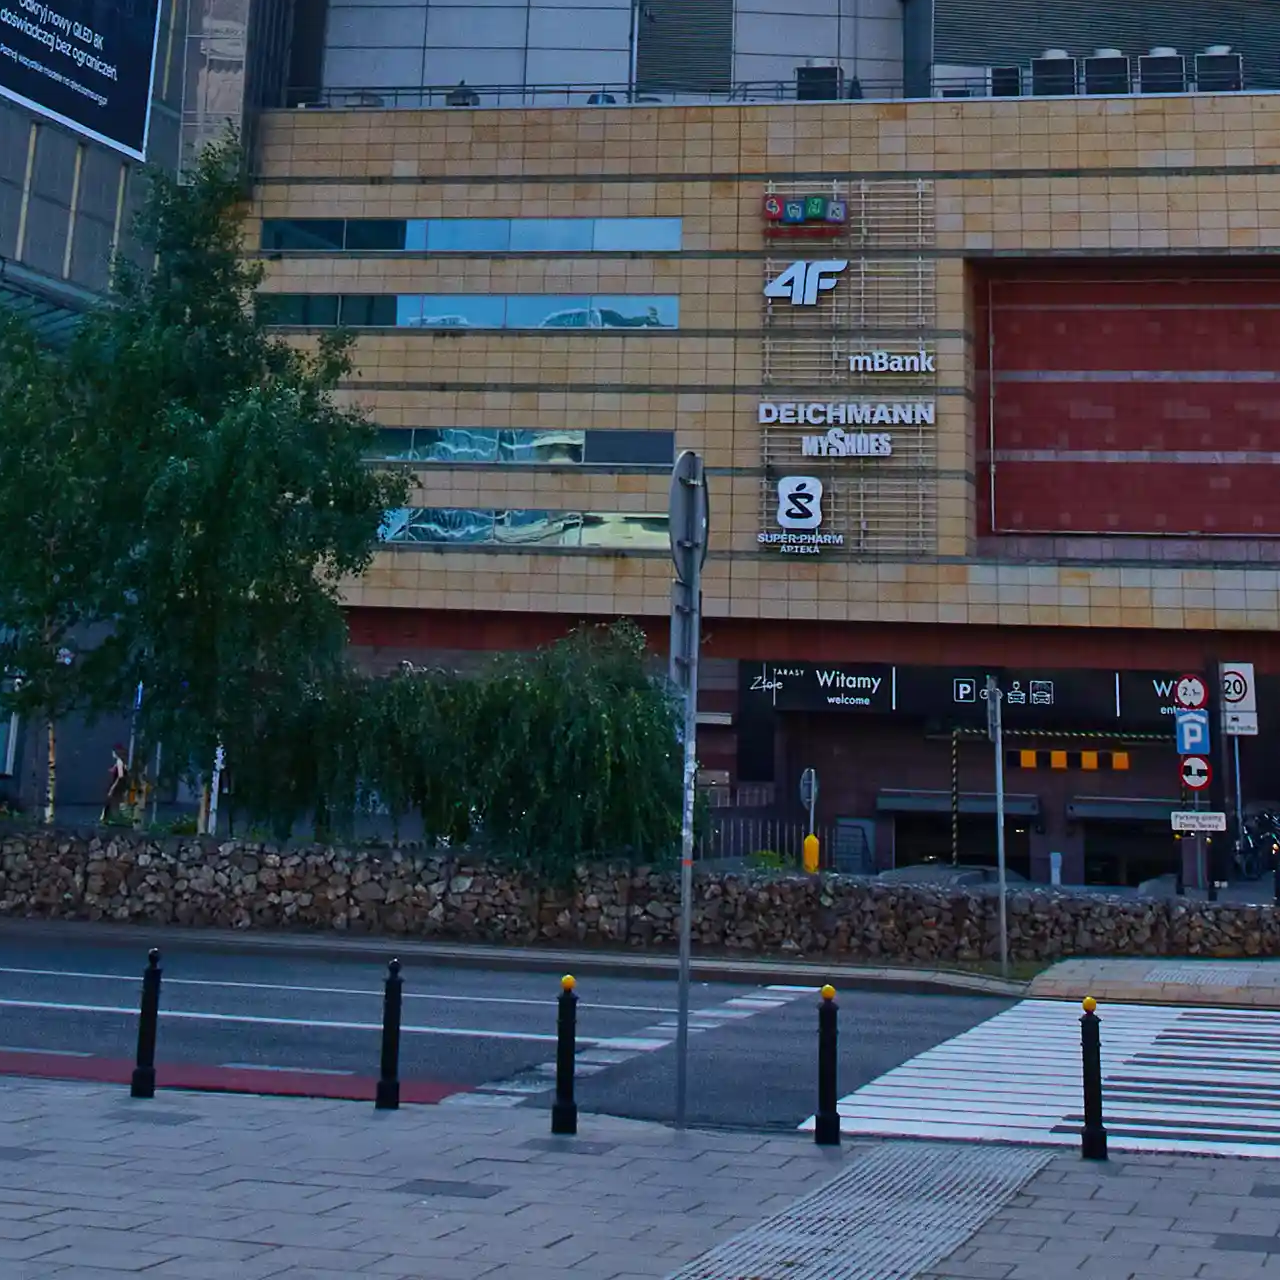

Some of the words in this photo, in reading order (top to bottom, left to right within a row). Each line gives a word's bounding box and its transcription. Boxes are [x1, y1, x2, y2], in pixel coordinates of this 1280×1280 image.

[764, 259, 849, 306] 4F
[849, 349, 936, 373] mBank
[758, 402, 936, 425] DEICHMANN
[773, 668, 805, 678] TARASY
[816, 669, 882, 695] Witamy
[959, 683, 972, 700] P
[1224, 679, 1244, 696] 20
[827, 693, 871, 706] welcome
[1183, 723, 1202, 751] P
